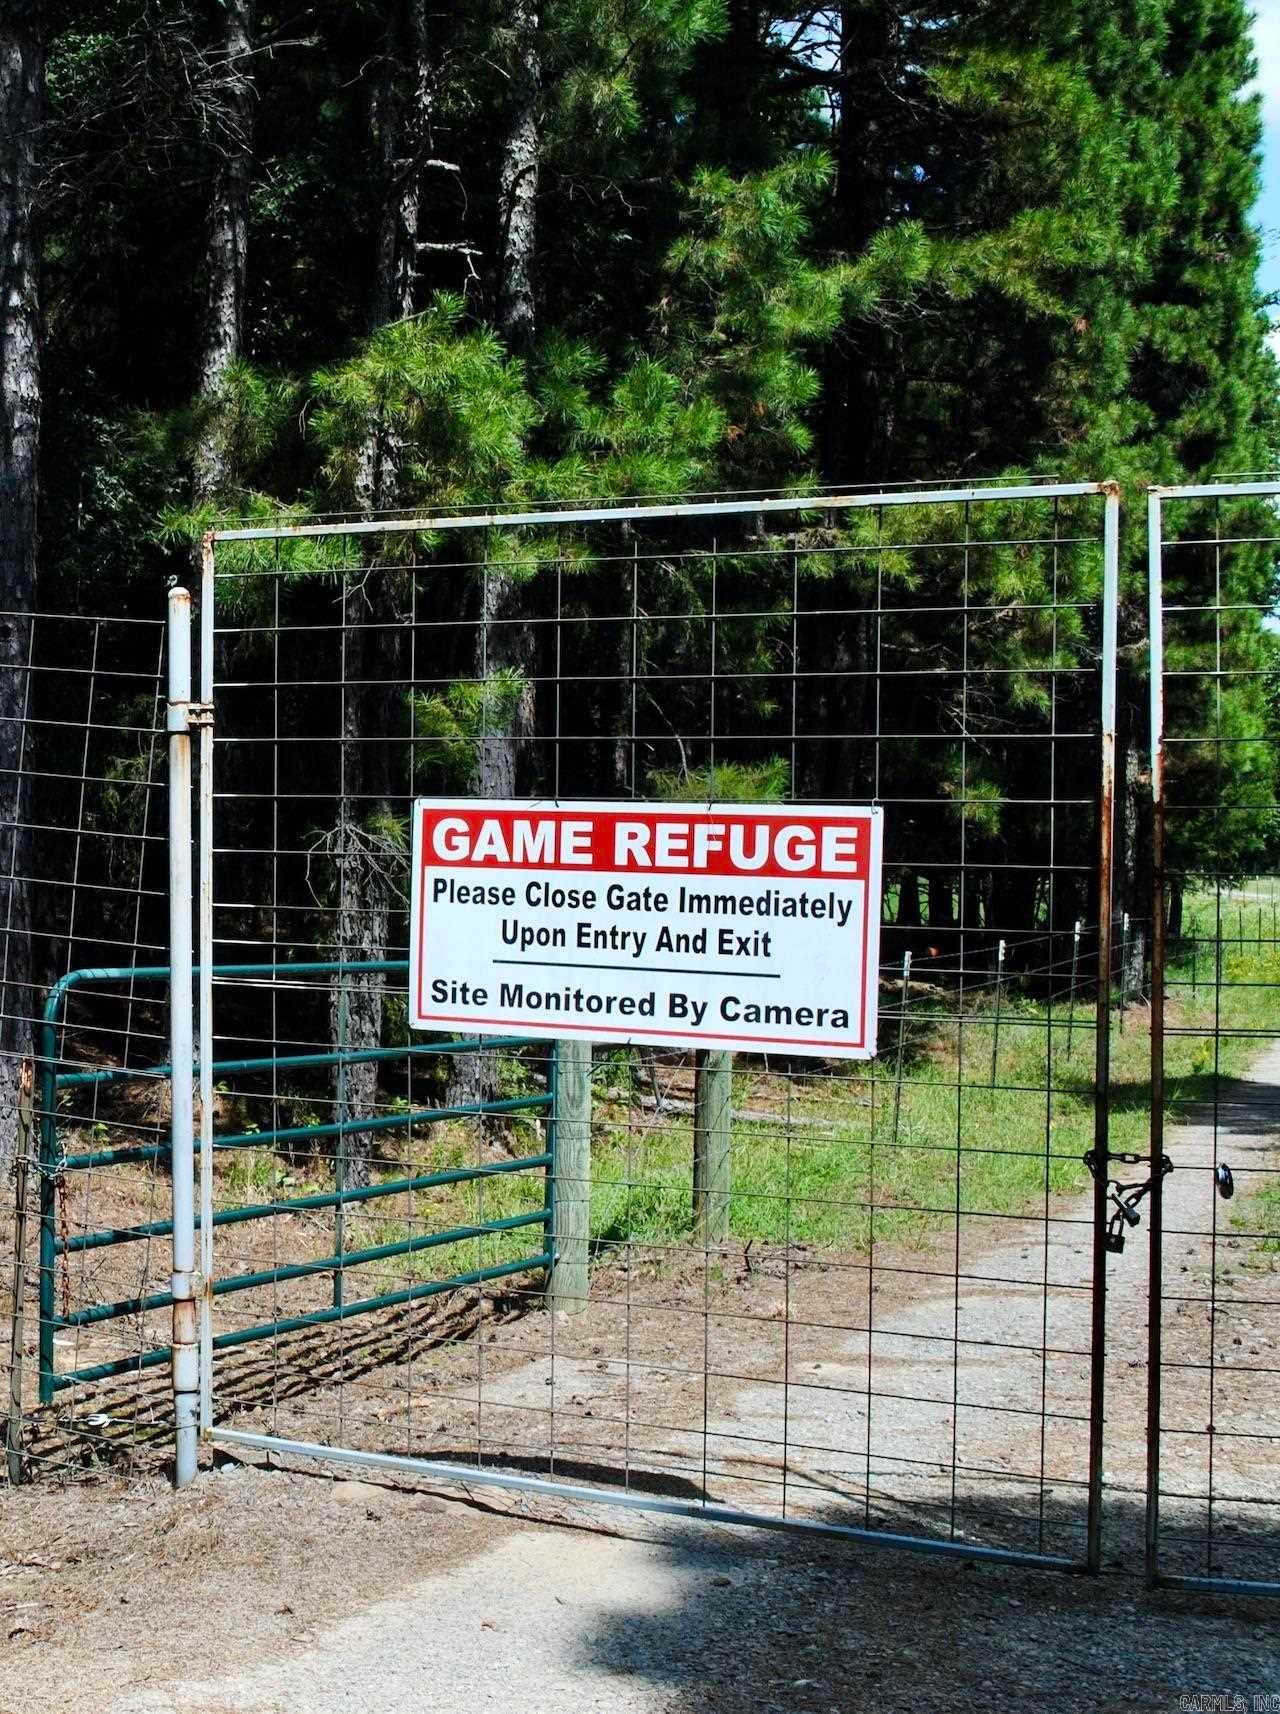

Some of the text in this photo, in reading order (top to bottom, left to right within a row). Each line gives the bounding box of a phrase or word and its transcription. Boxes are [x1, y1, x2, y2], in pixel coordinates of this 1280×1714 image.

[432, 817, 858, 873] GAME REFUGE
[433, 878, 853, 926] Please Close Gate Immediately
[501, 919, 771, 957] Upon Entry And Exit
[431, 979, 850, 1028] Site Monitored By Camera
